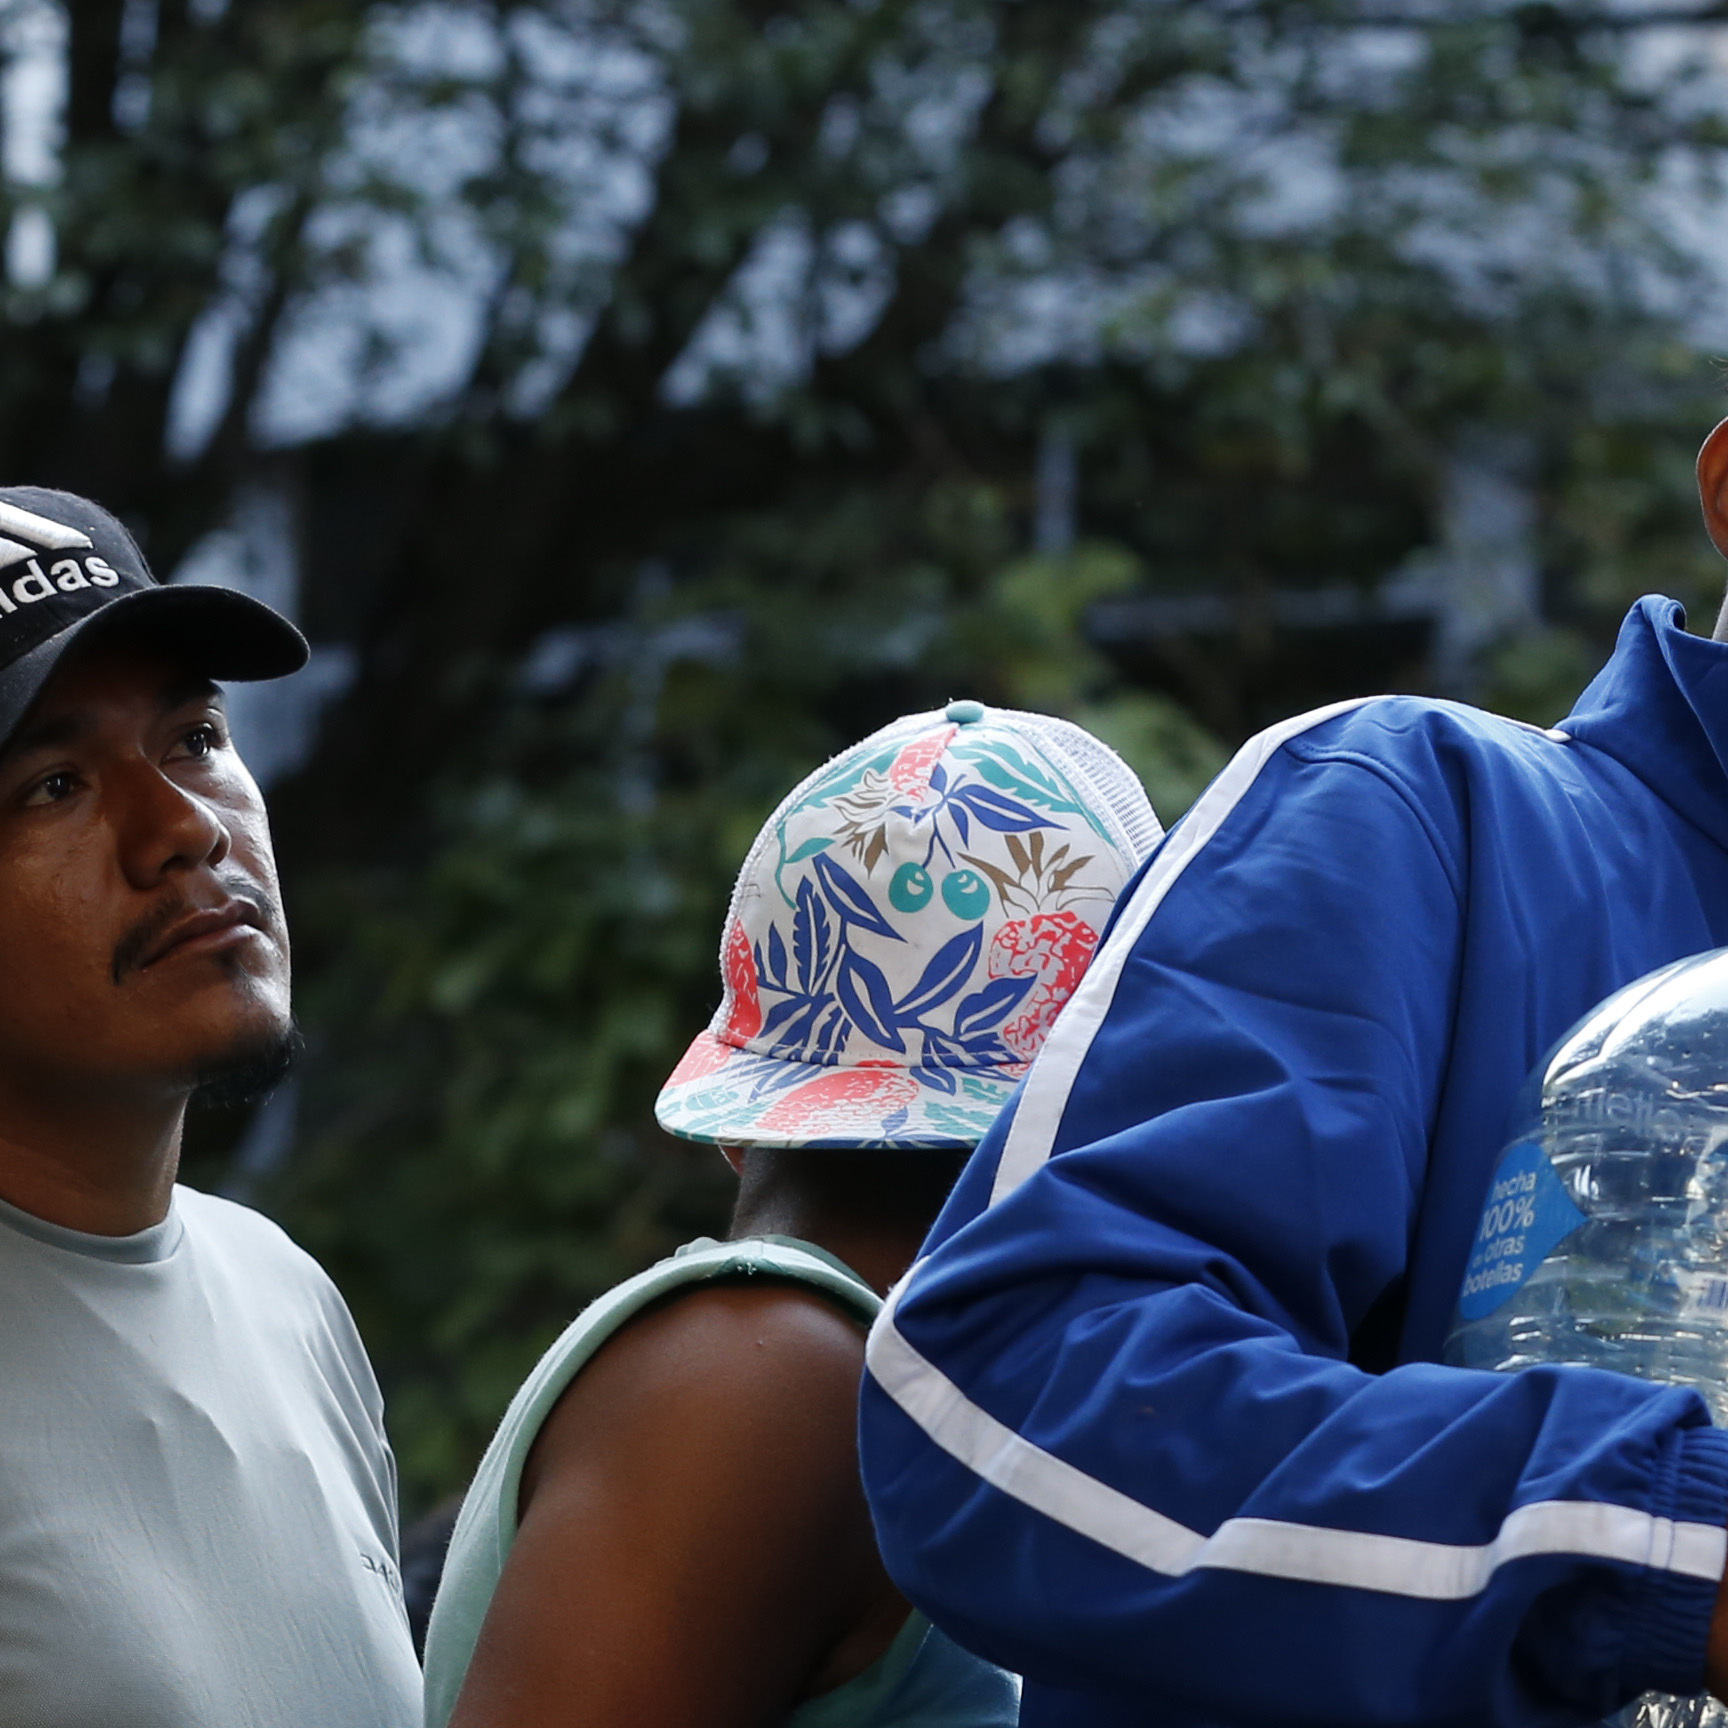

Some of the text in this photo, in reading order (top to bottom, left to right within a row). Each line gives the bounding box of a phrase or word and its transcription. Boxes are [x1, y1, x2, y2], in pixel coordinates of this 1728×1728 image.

[1479, 1195, 1536, 1242] 100%
[1484, 1235, 1526, 1263] otras
[1461, 1261, 1524, 1297] botellas
